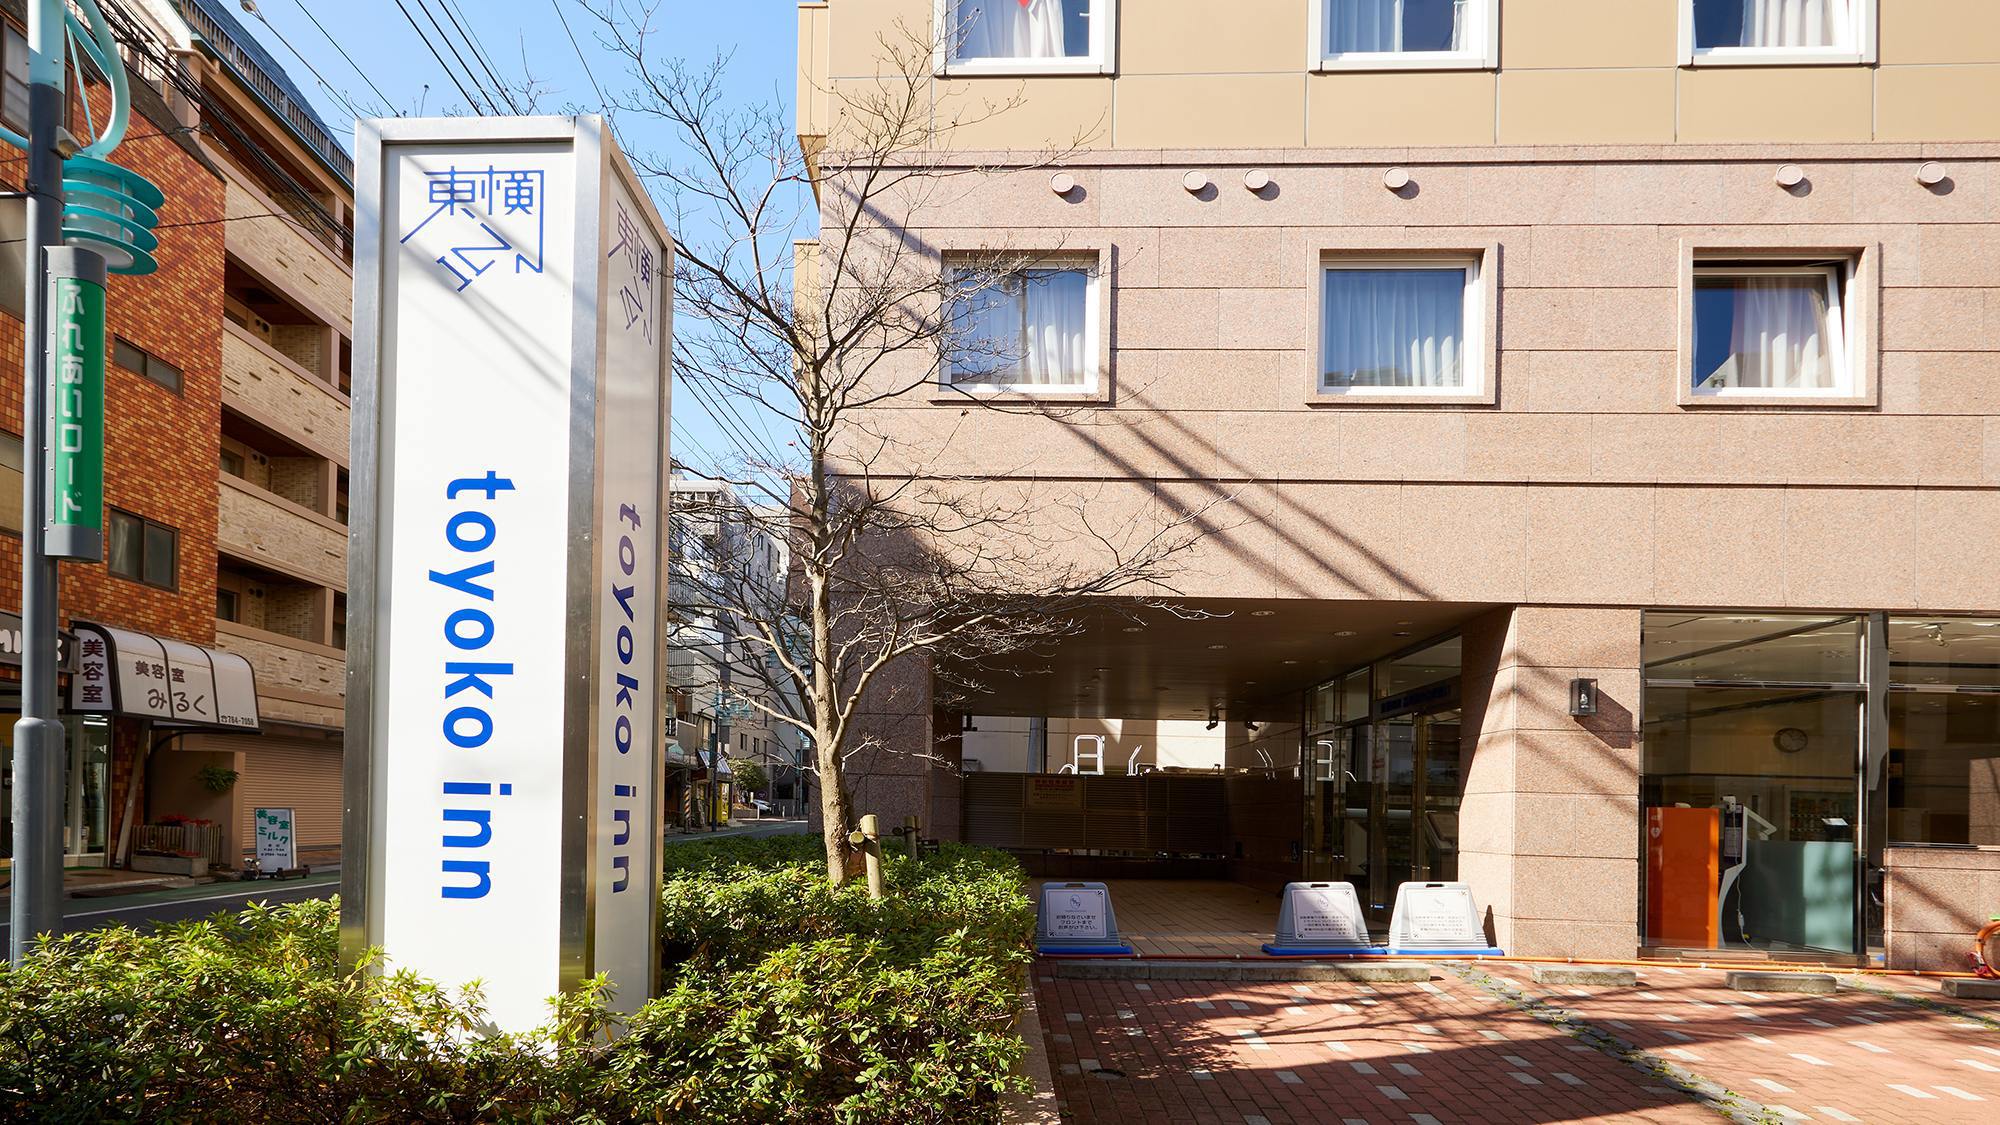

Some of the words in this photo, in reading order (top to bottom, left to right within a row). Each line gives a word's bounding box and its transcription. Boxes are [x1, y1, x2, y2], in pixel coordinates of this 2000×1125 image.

[61, 283, 86, 522] ふれあいロード
[428, 470, 516, 749] toyoko
[612, 502, 642, 755] toyoko
[81, 638, 104, 703] 美容室
[135, 660, 185, 683] 美容室
[147, 688, 207, 716] みるく
[256, 808, 290, 830] 美容室
[258, 826, 289, 844] ミルク
[441, 781, 513, 899] inn
[612, 783, 637, 894] inn
